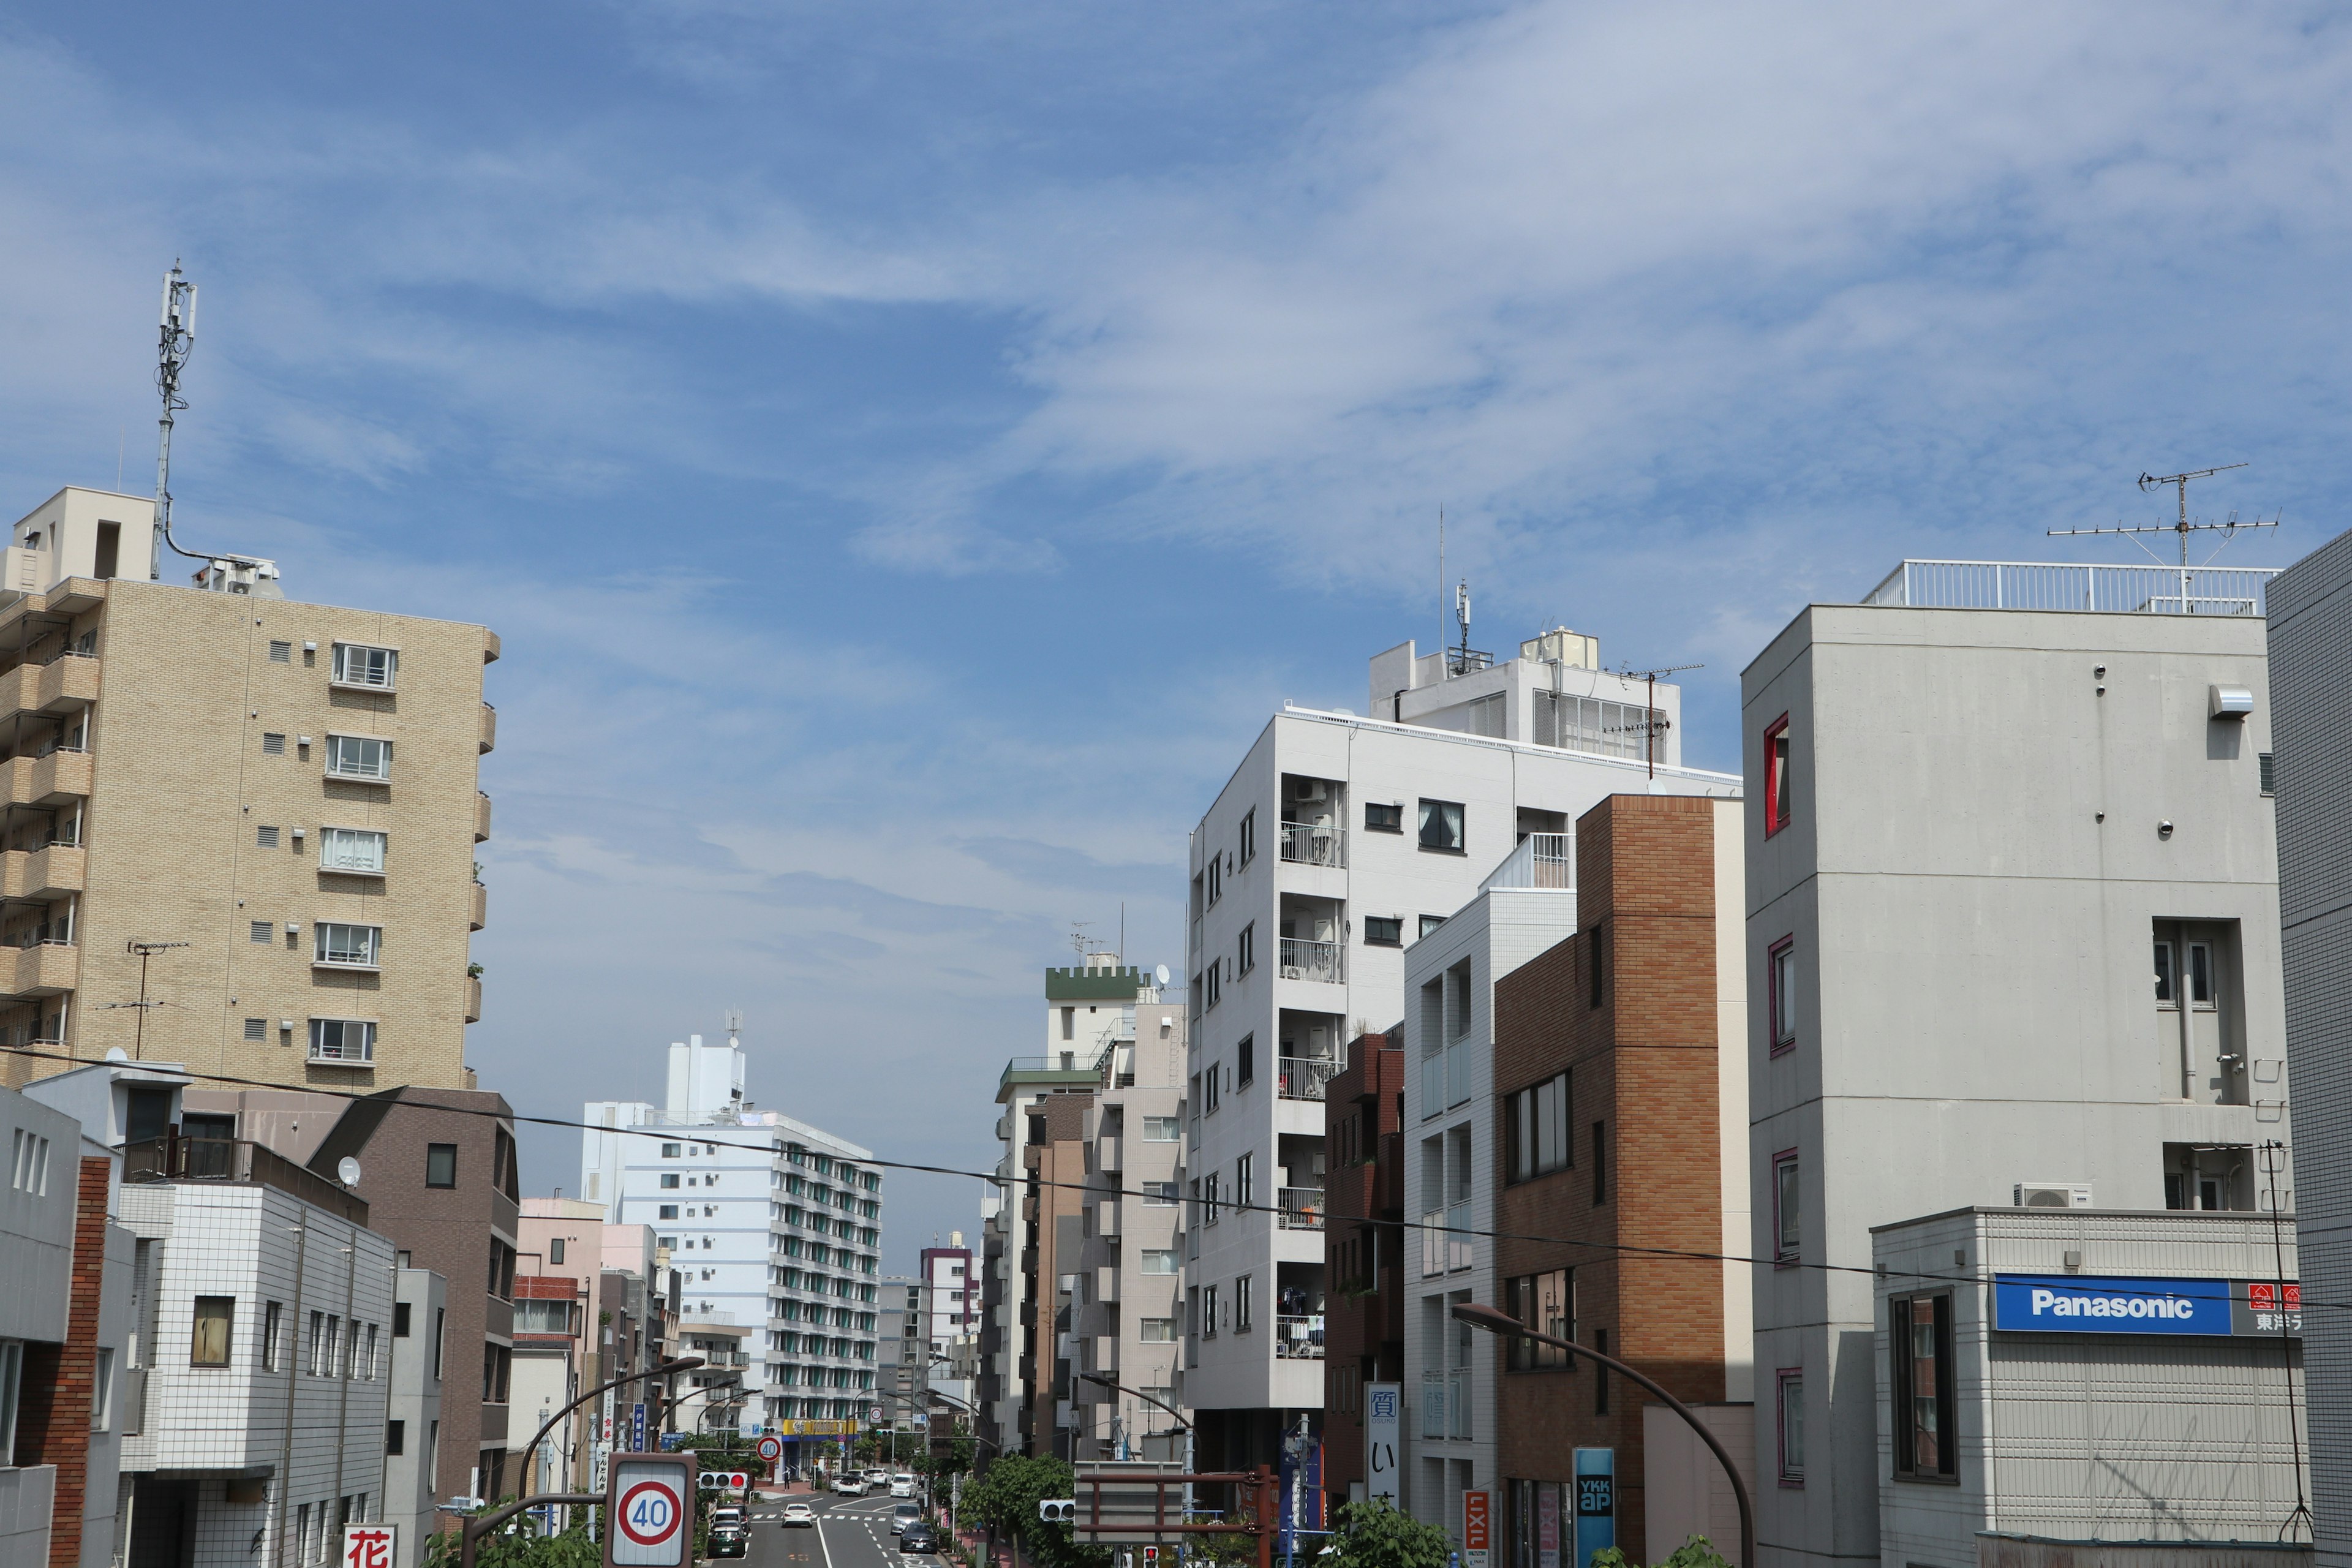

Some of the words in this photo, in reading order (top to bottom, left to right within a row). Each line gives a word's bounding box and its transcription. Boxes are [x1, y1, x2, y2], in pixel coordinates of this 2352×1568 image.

[2032, 1289, 2193, 1319] Panasonic
[1371, 1391, 1396, 1417] 質
[762, 1444, 775, 1454] 40
[1580, 1480, 1610, 1492] YKK
[632, 1499, 666, 1527] 40
[1469, 1496, 1485, 1545] LIXIL
[348, 1530, 390, 1568] 花
